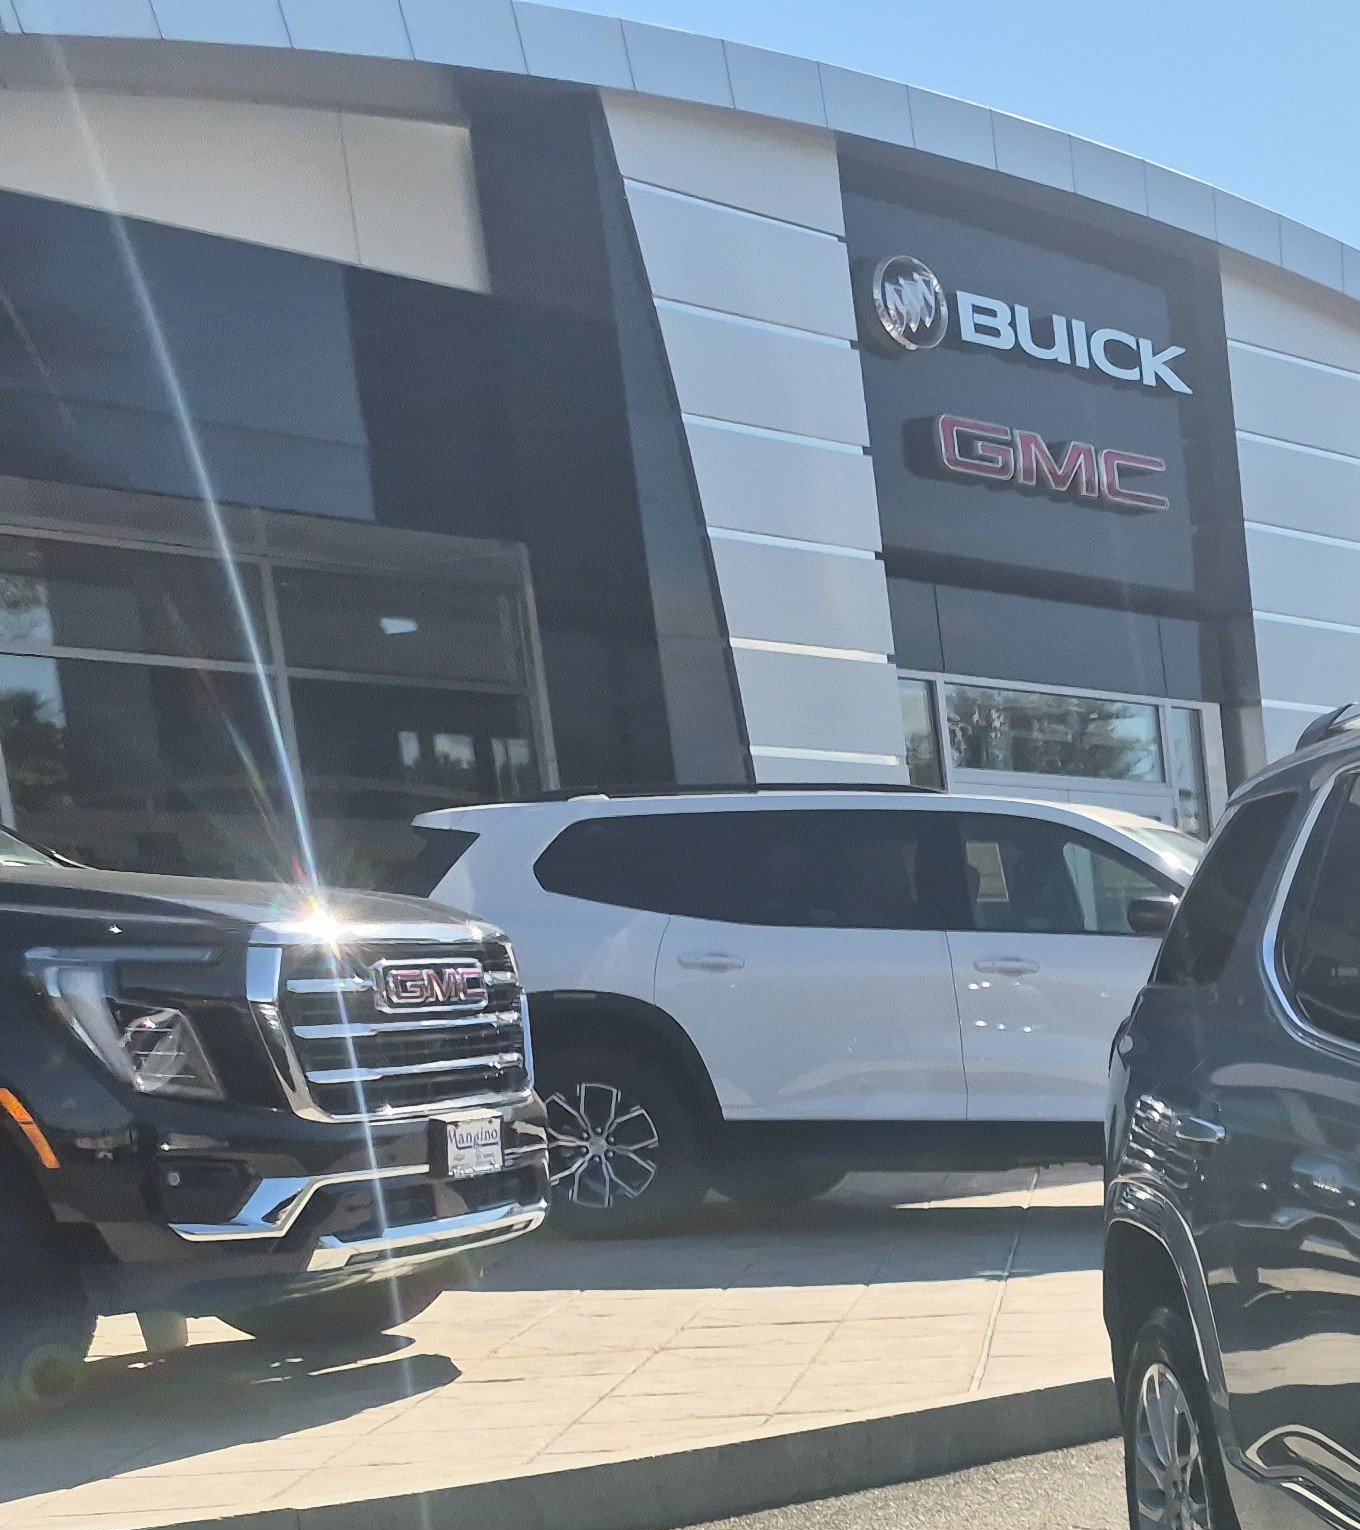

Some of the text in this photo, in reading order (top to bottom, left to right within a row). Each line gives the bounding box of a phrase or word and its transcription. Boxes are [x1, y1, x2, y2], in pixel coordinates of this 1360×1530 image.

[956, 290, 1193, 395] BUICK
[939, 413, 1169, 509] GMC
[386, 968, 488, 1003] GMC
